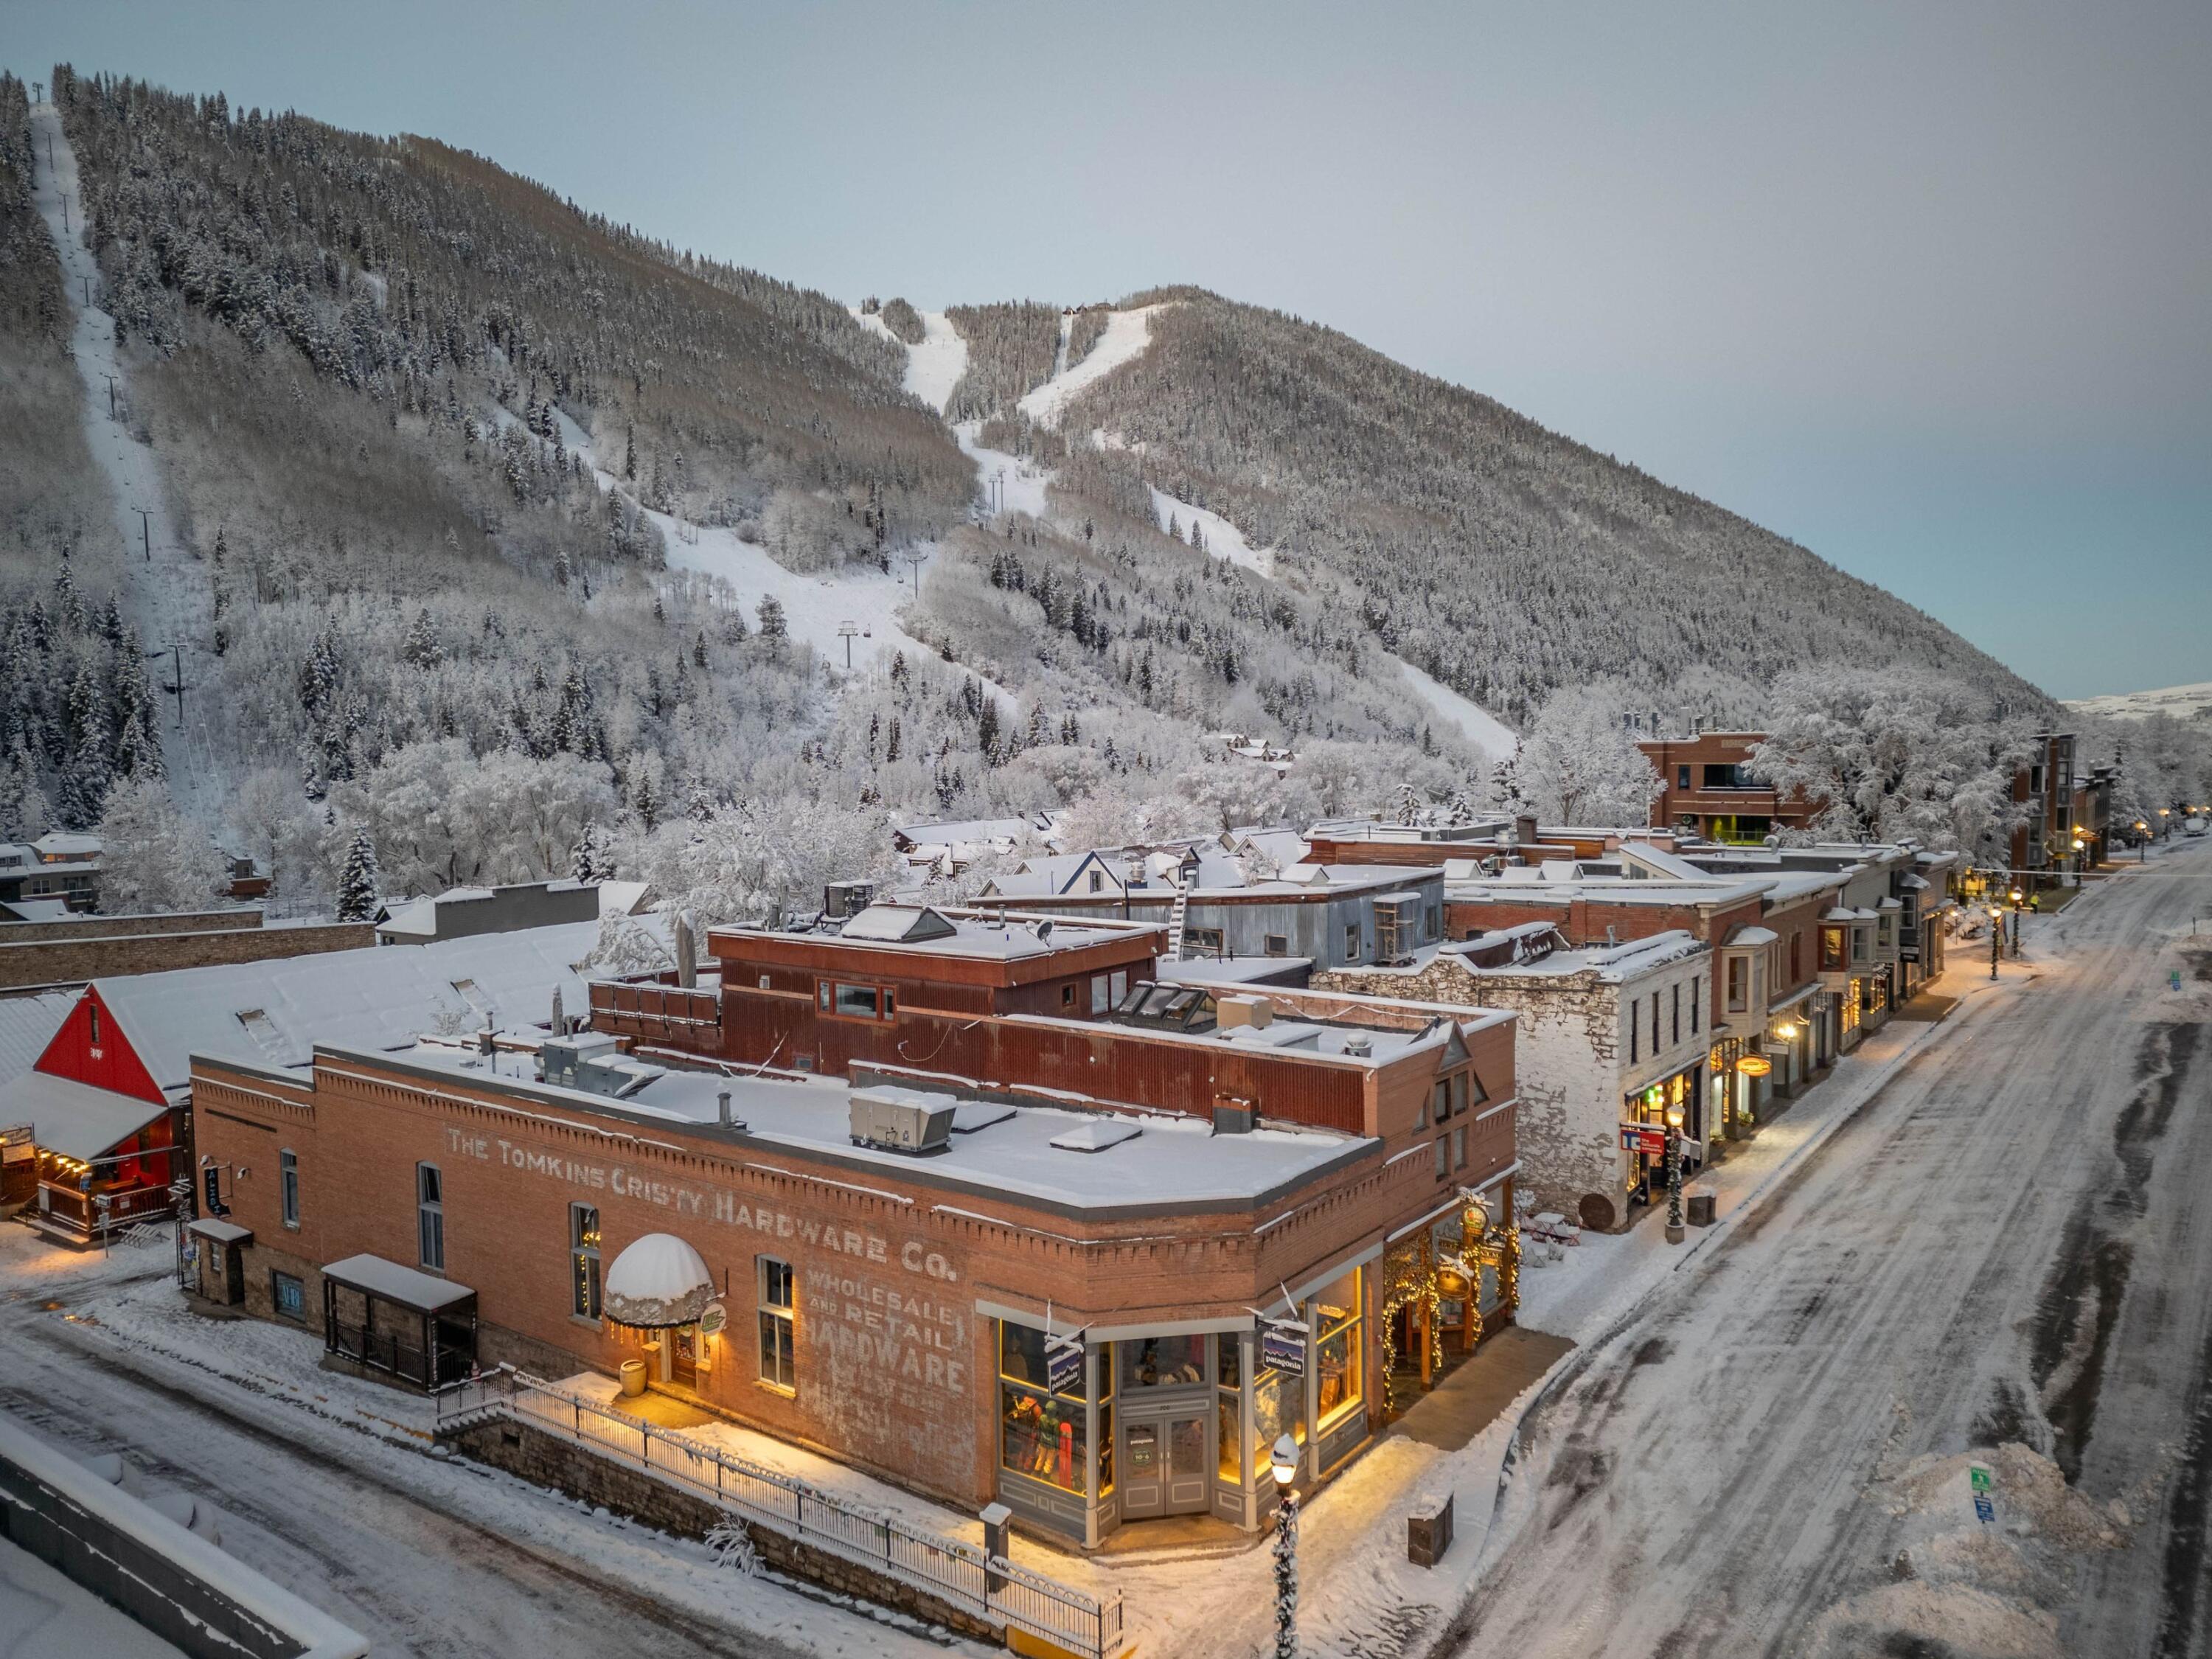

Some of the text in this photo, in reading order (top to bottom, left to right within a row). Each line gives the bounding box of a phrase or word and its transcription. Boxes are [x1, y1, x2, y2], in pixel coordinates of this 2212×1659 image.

[208, 1171, 220, 1214] ALIBI
[448, 1128, 488, 1160] THE
[498, 1139, 605, 1189] TOMKINS
[715, 1190, 888, 1264] HARDWARE
[901, 1241, 957, 1281] CO.
[807, 1269, 954, 1326] WHOLESALE
[810, 1296, 953, 1352] AND RETAIL
[1051, 1371, 1078, 1391] patagonia
[1265, 1356, 1301, 1370] patagonia
